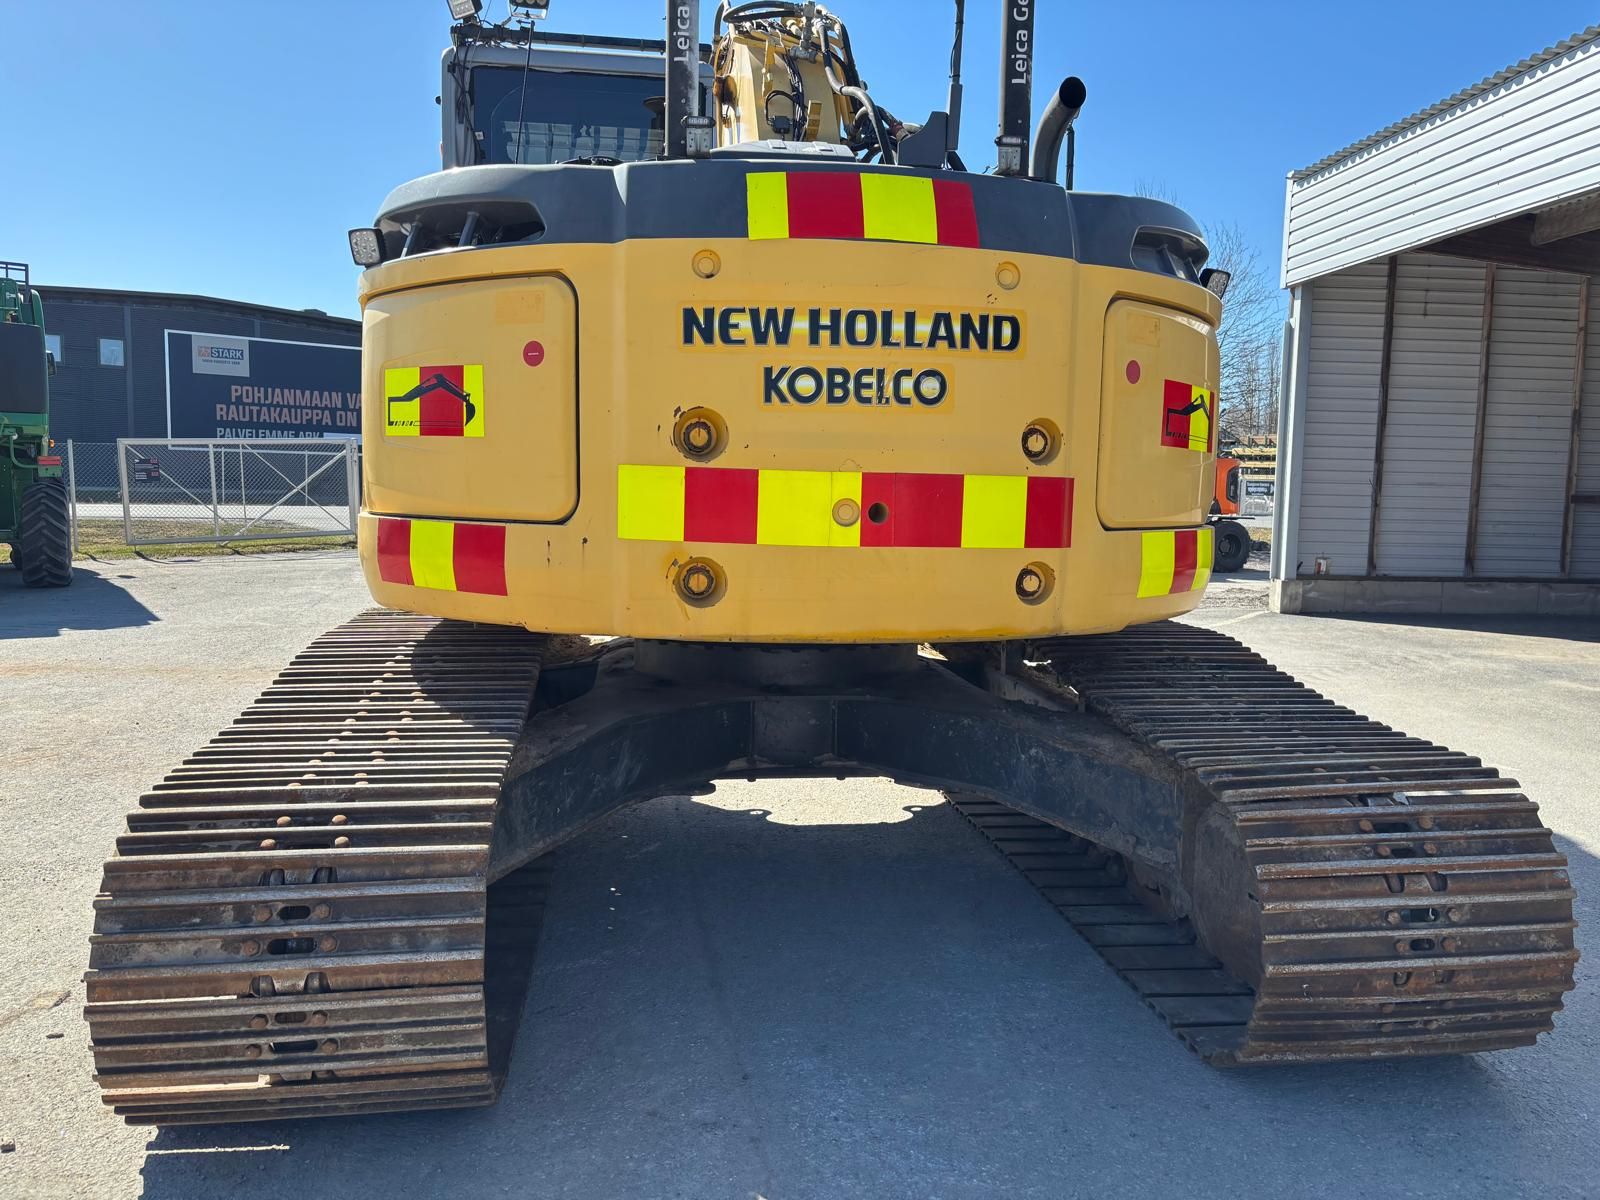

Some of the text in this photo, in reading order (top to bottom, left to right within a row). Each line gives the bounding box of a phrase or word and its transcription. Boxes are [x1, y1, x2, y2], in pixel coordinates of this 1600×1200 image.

[673, 6, 690, 62] Leica
[1011, 29, 1028, 84] Leica
[682, 306, 1021, 352] NEW HOLLAND
[211, 348, 243, 360] STARK
[231, 385, 342, 408] POHJANMAAN
[763, 365, 948, 407] KOBELCO
[215, 403, 357, 427] RAUTAKAUPPA ON
